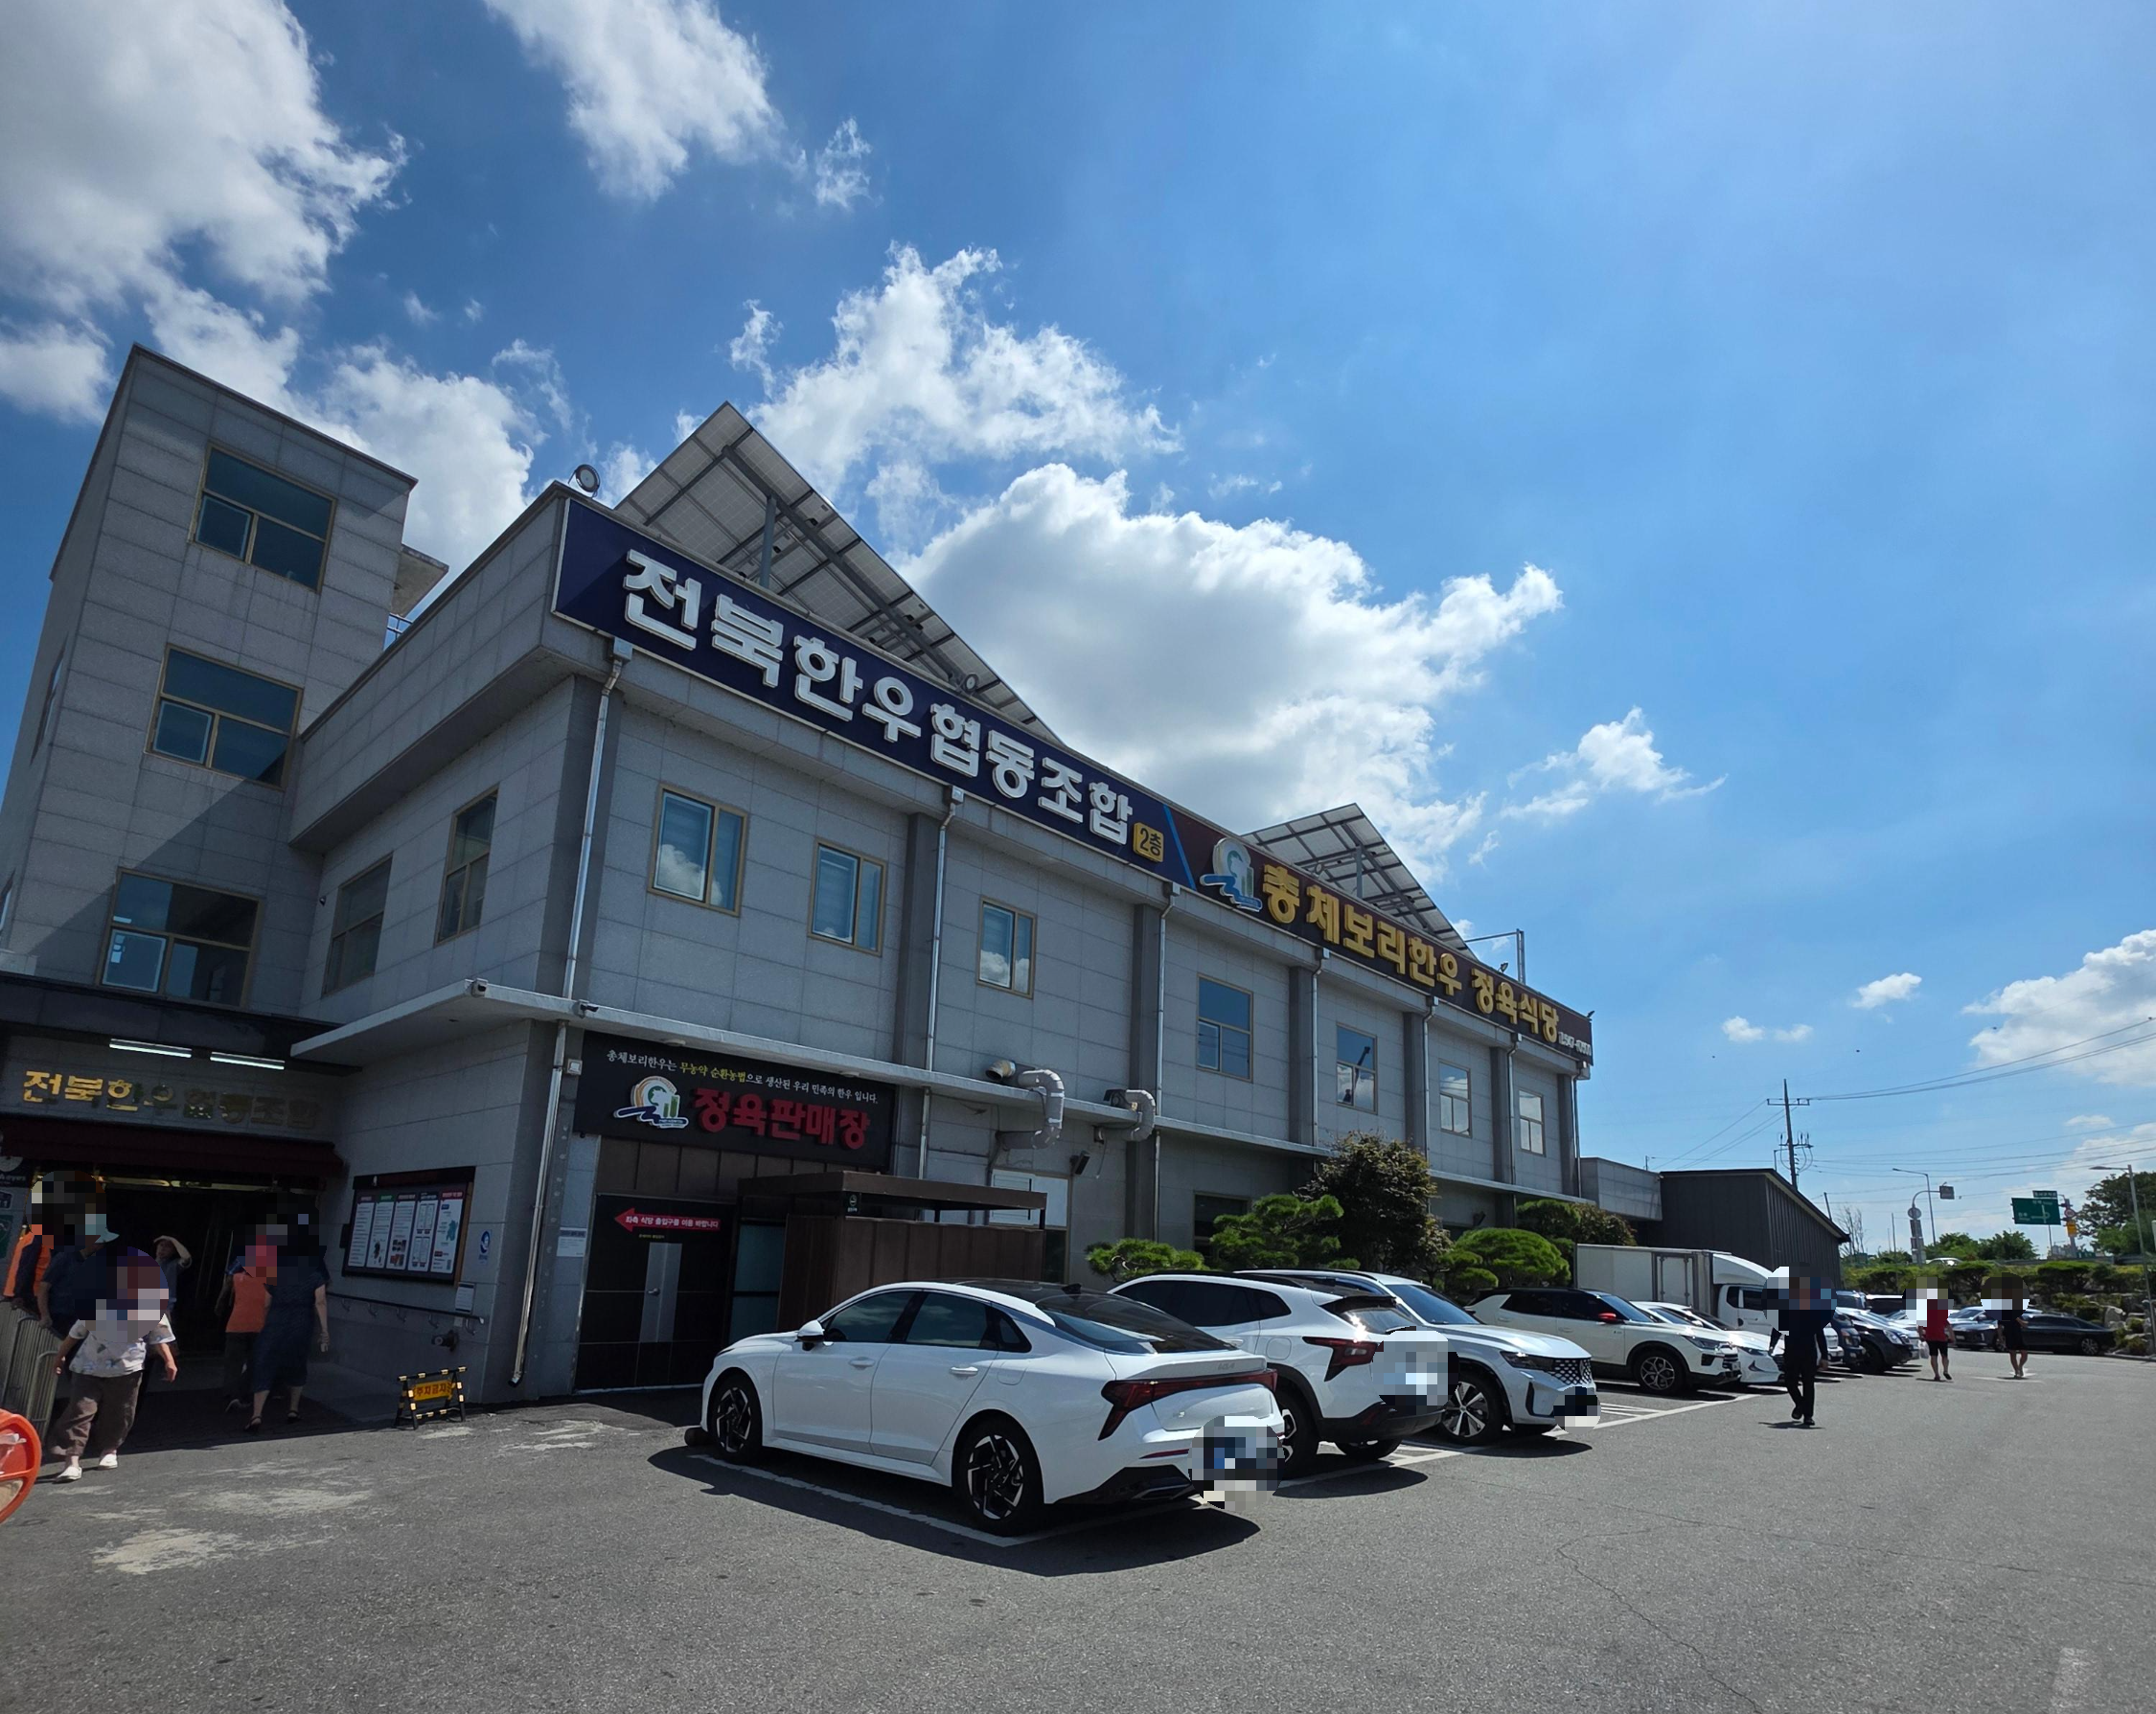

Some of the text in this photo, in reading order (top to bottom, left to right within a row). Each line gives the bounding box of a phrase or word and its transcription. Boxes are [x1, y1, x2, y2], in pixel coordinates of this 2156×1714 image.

[623, 549, 1133, 845] 전북한우협동조합
[1137, 826, 1163, 860] 2층
[1263, 864, 1560, 1043] 총체보리한우 정육식당
[607, 1049, 677, 1072] 총체보리한우는
[679, 1063, 708, 1076] 무농약
[710, 1067, 763, 1084] 순환농법으로
[766, 1076, 791, 1089] 생산된
[793, 1081, 809, 1092] 우리
[812, 1084, 836, 1097] 민족의
[837, 1087, 853, 1100] 한우
[692, 1087, 871, 1150] 정육판매장
[695, 1220, 719, 1228] 바랍니다
